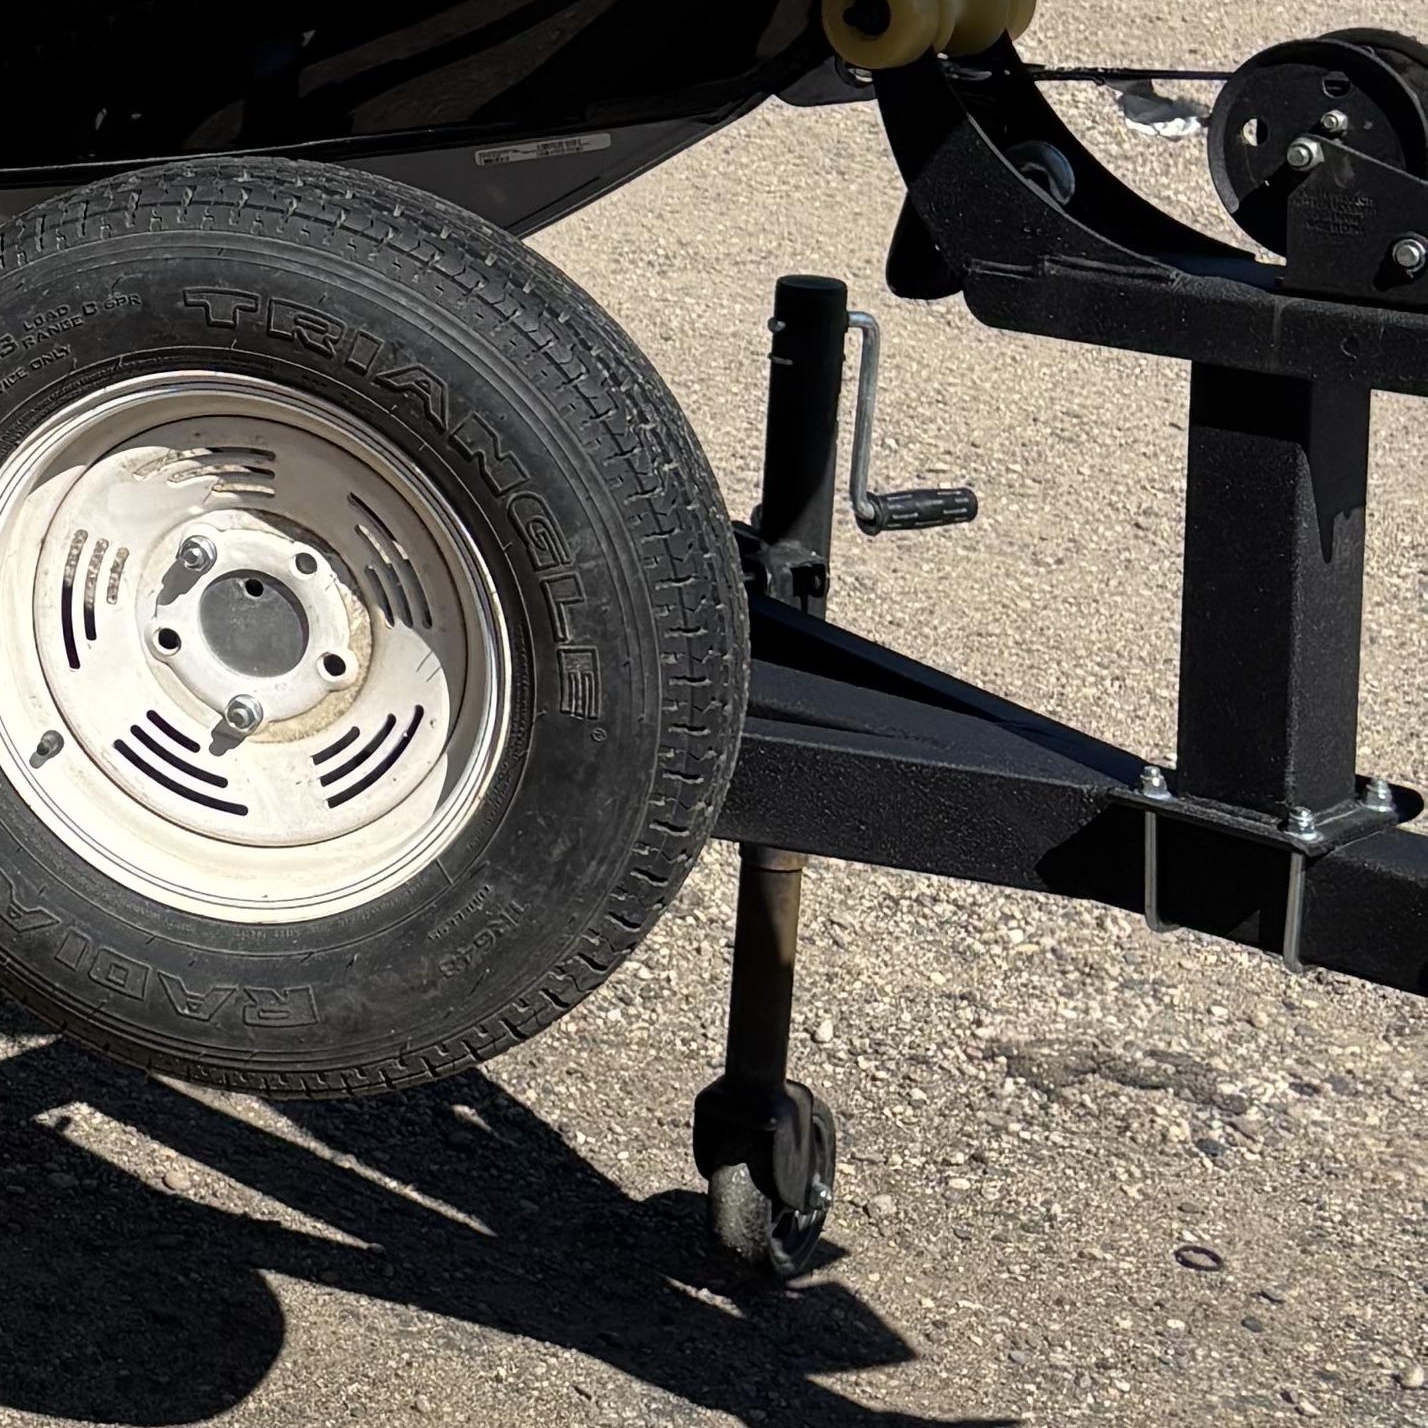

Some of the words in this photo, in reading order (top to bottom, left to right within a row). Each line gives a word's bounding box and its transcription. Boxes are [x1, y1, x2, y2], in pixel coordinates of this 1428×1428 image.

[21, 316, 84, 350] RANGE
[23, 304, 71, 332] LOAD
[30, 343, 72, 372] ONLY
[181, 284, 602, 722] TRIANGLE
